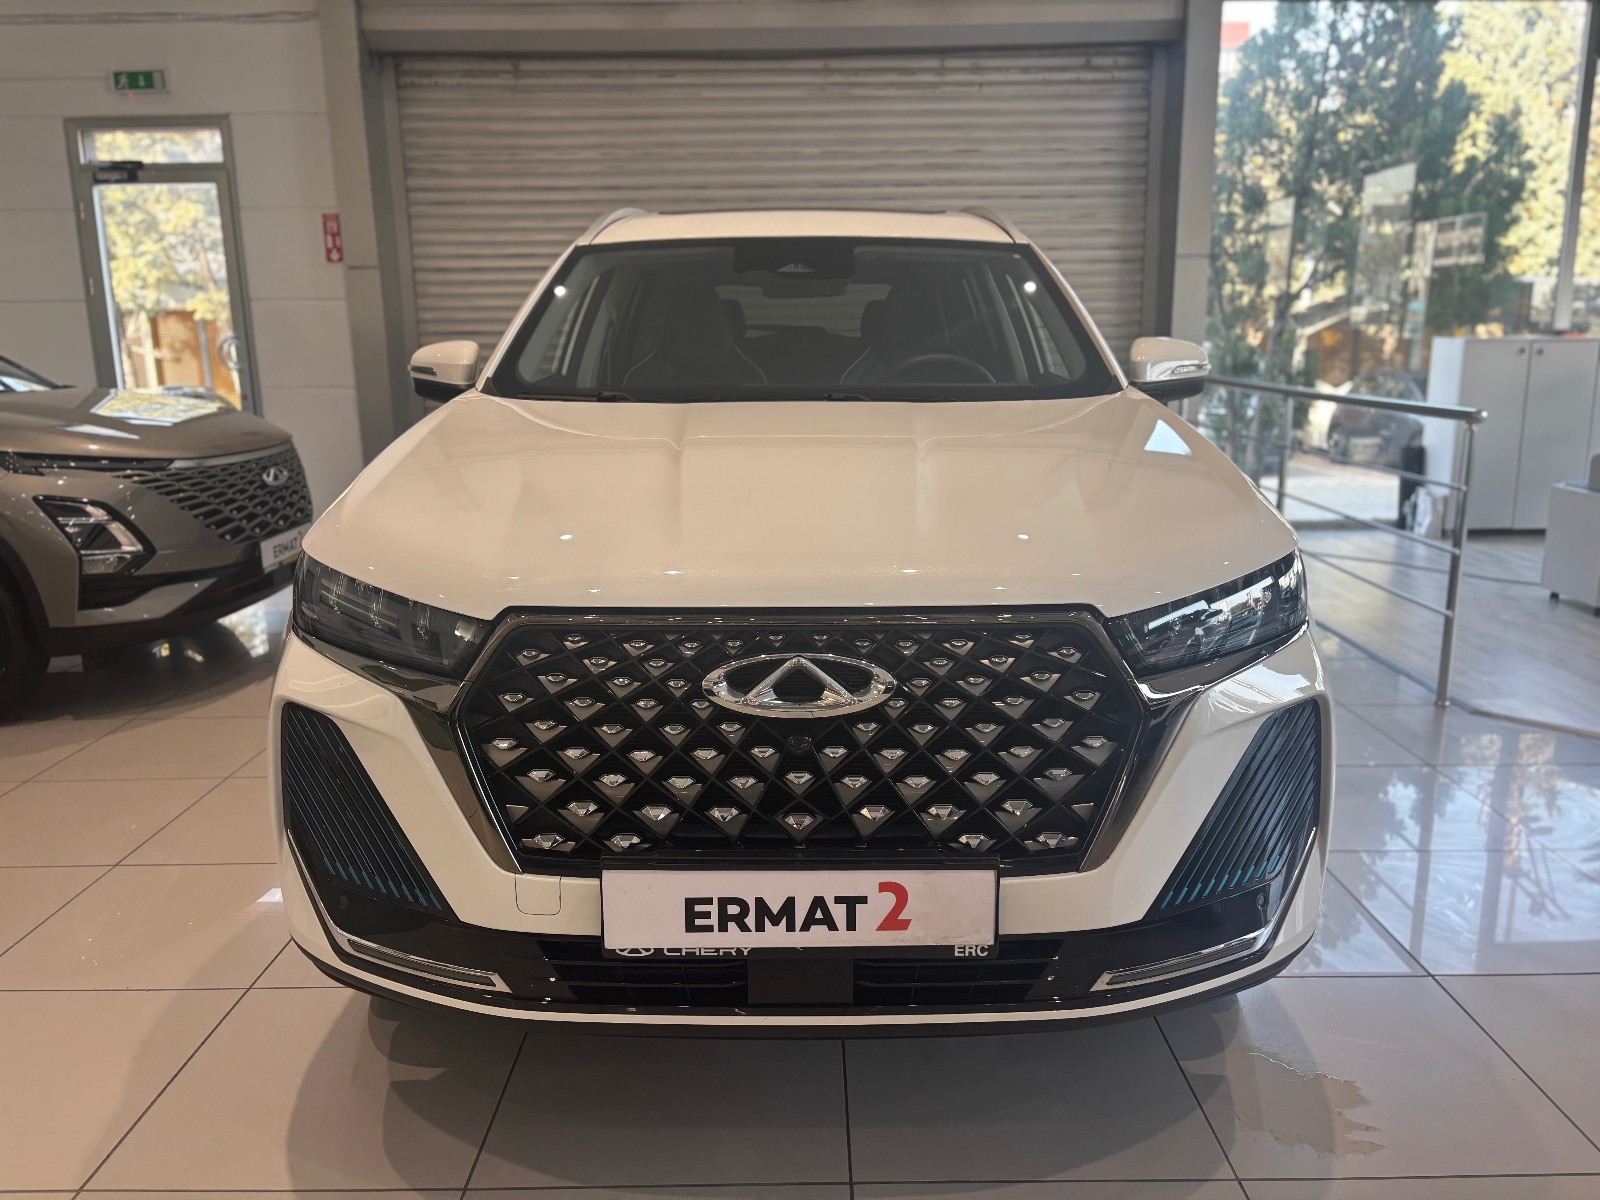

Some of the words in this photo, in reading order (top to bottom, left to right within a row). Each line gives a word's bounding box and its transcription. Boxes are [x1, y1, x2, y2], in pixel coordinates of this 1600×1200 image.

[684, 895, 868, 933] ERMAT
[875, 881, 913, 931] 2
[954, 944, 989, 957] ERC
